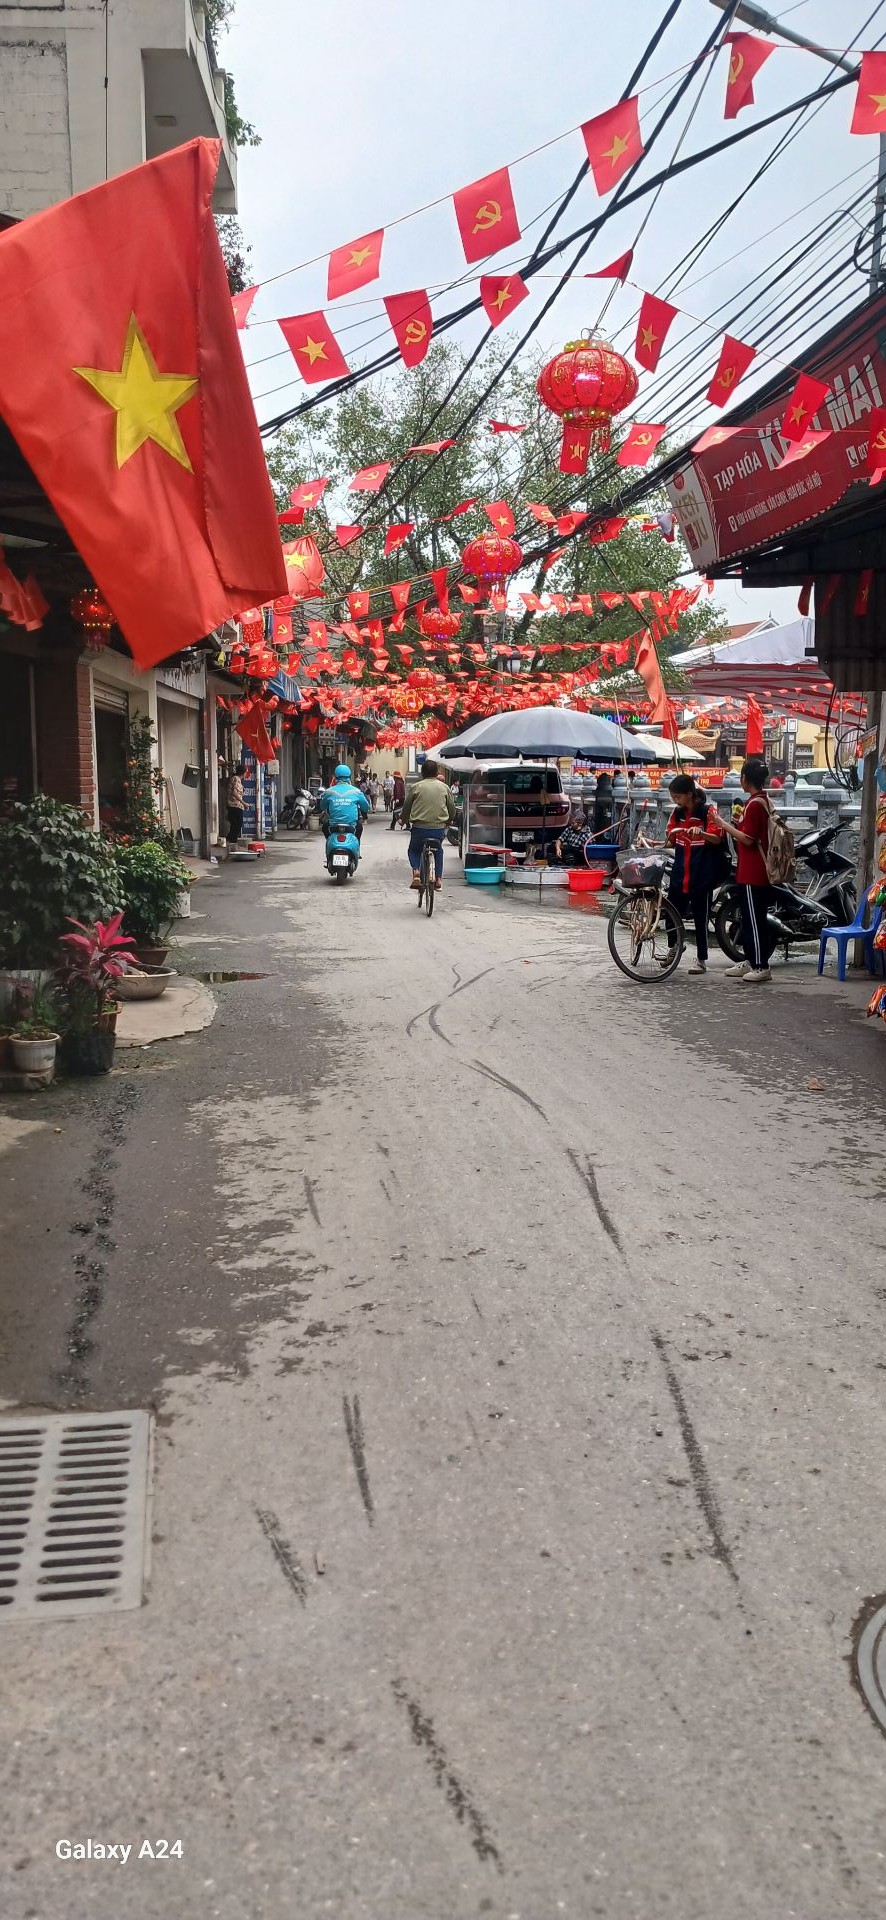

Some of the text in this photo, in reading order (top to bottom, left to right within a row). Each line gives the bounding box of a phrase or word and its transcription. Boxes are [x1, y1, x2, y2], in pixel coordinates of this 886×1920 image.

[825, 354, 883, 433] MAI
[713, 466, 735, 492] TẠP
[736, 451, 762, 479] HÓA
